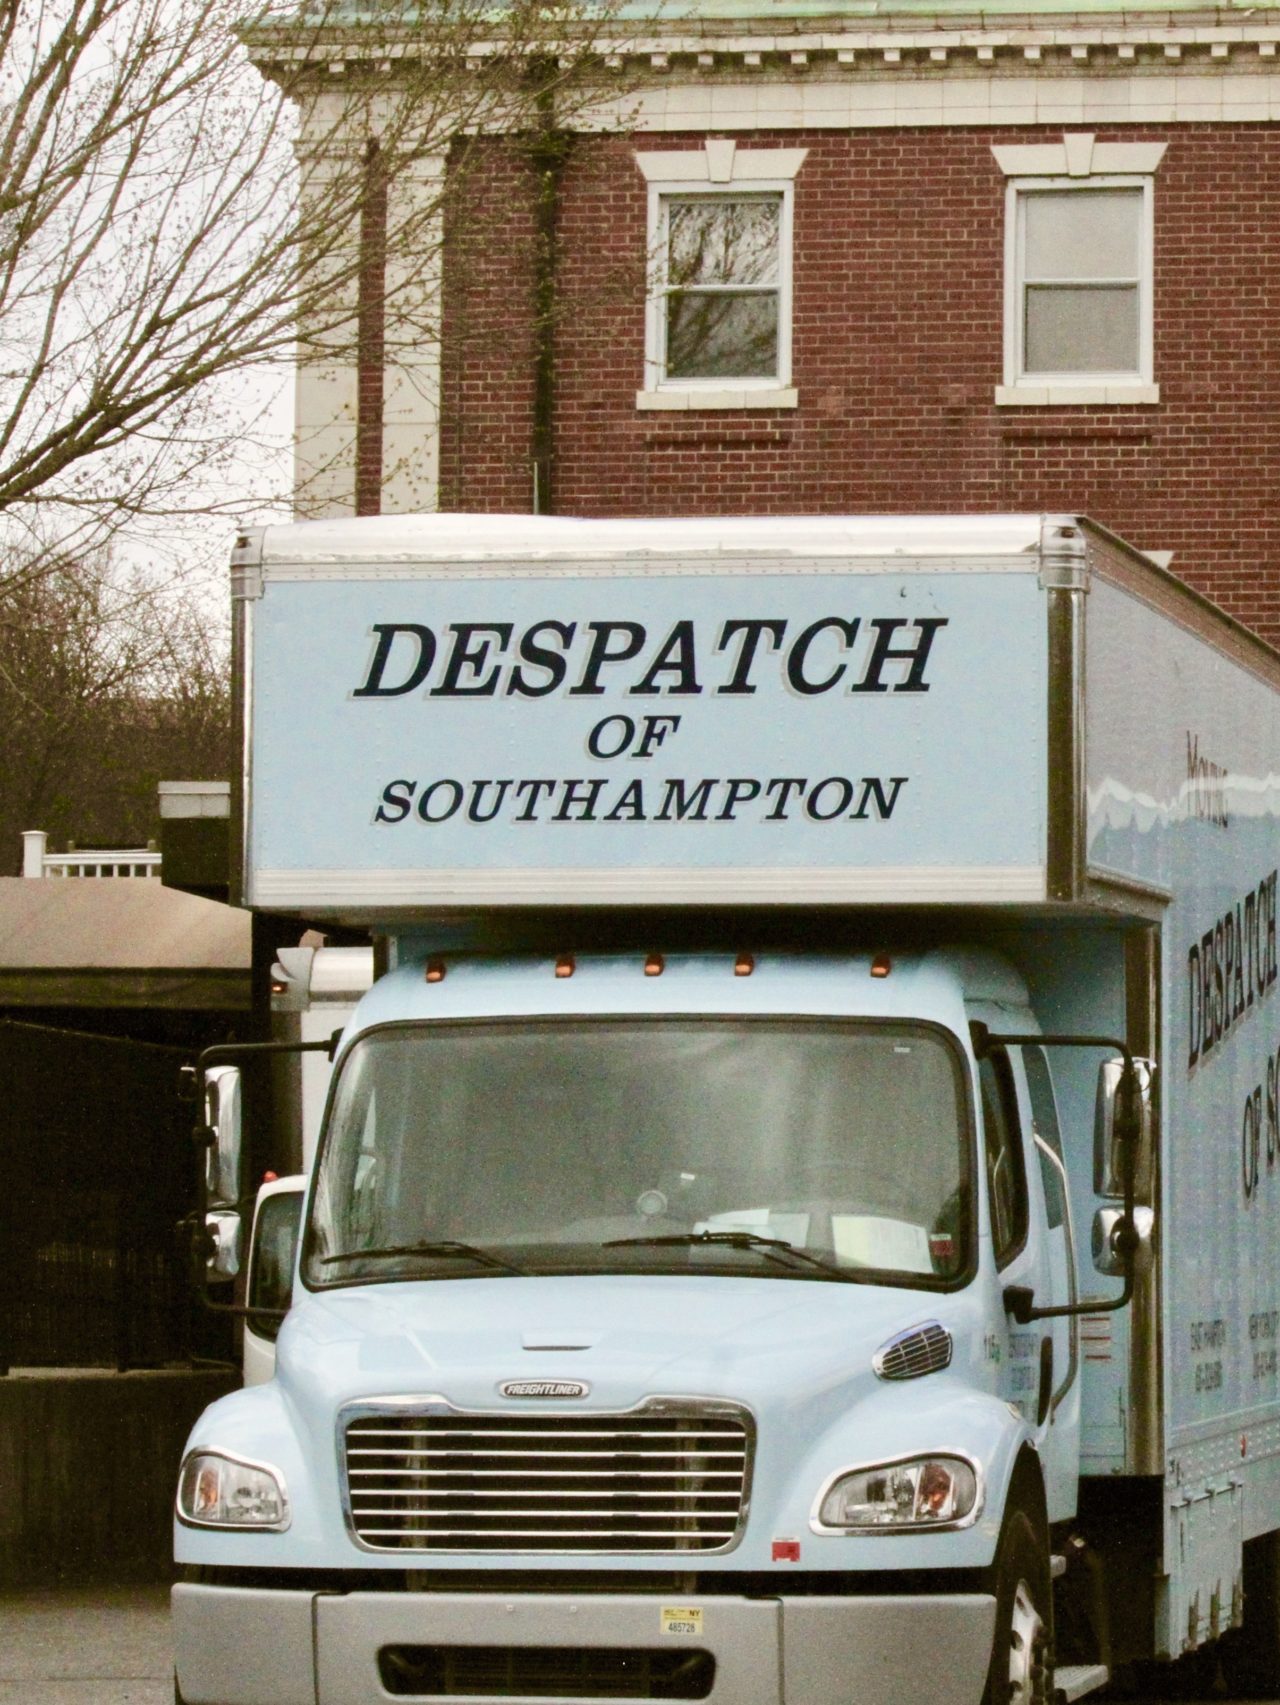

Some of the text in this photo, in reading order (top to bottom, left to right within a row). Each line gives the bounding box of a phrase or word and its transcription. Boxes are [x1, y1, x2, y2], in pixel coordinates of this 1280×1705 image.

[350, 615, 949, 700] DESPATCH
[586, 713, 682, 761] OF
[373, 776, 910, 826] SOUTHAMPTON
[1188, 869, 1278, 1072] DESPATCH
[1242, 1084, 1262, 1200] OF
[506, 1383, 580, 1396] FREIGHTLINER
